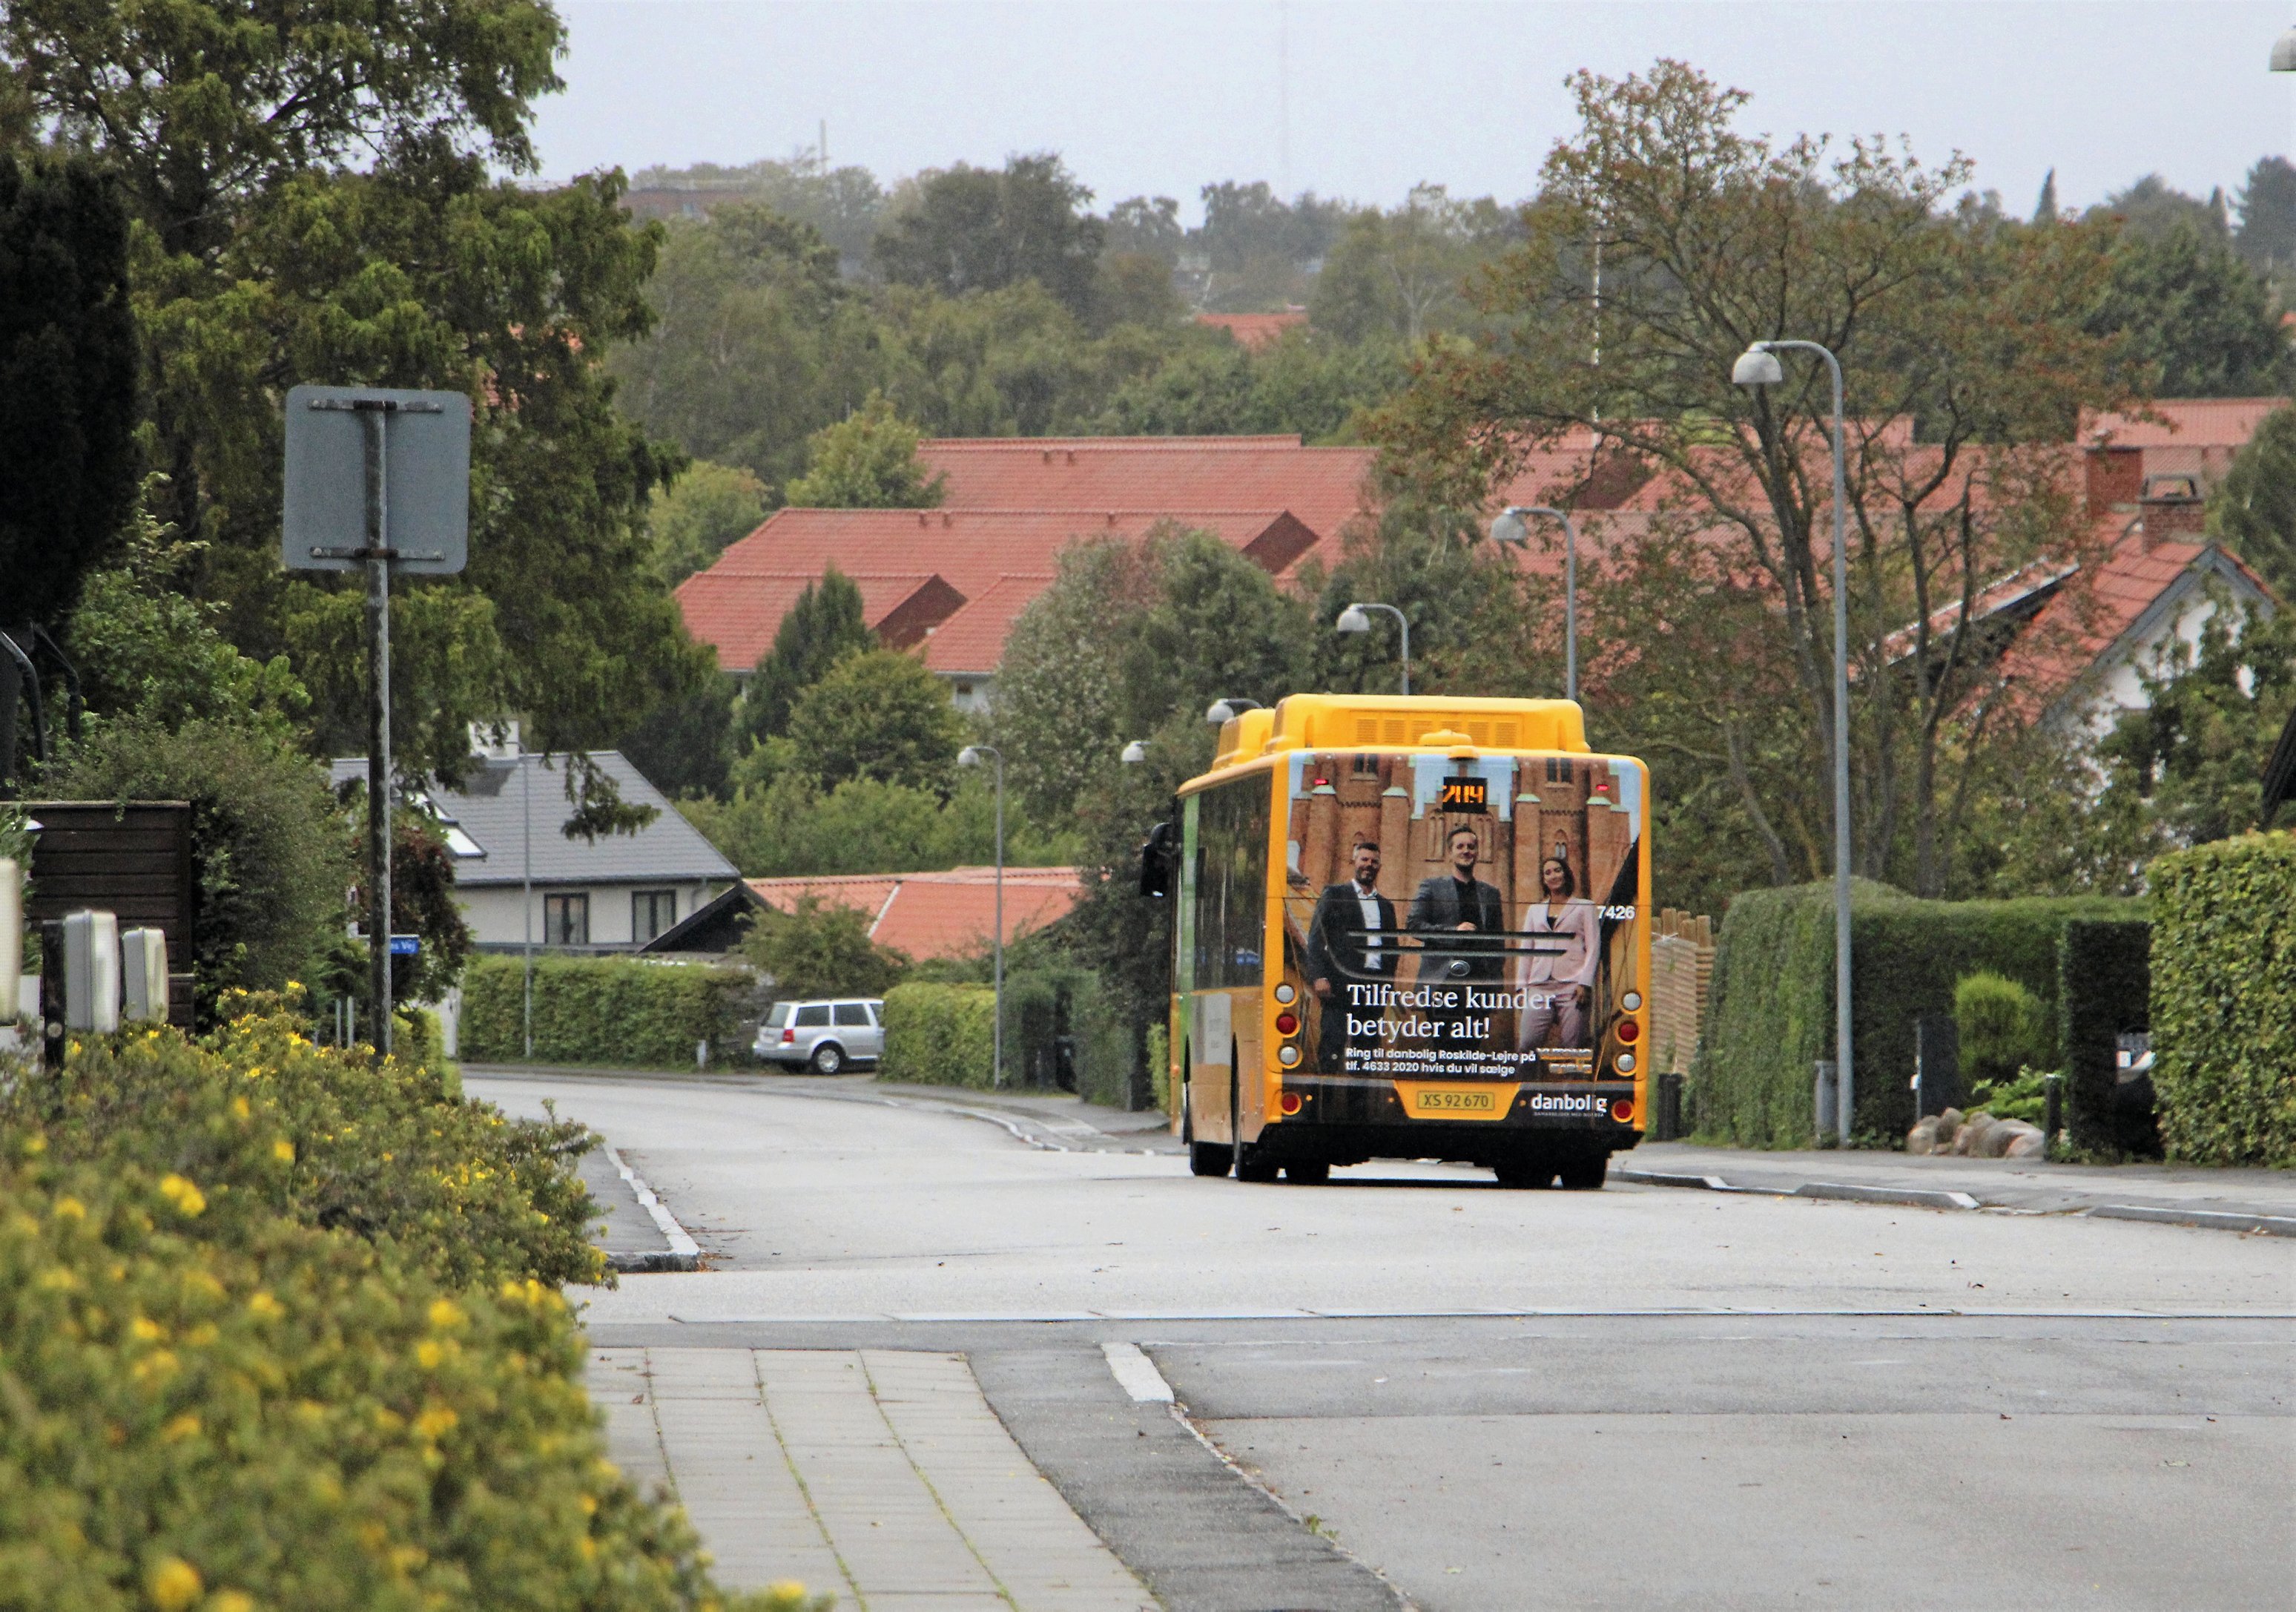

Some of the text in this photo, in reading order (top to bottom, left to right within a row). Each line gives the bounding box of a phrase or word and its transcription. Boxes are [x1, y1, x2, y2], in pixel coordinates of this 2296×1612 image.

[1597, 904, 1636, 920] 7426
[1347, 984, 1556, 1010] Tilfredse kunder
[1346, 1013, 1491, 1043] betyder alt!
[1346, 1047, 1371, 1061] Ring
[1373, 1048, 1385, 1058] til
[1386, 1049, 1437, 1062] danbolig
[1439, 1050, 1519, 1064] Roskilde-Lejre
[1520, 1050, 1536, 1064] på
[1345, 1061, 1516, 1077] tlf. 4633 2020 hvis du vil sælge
[1424, 1094, 1489, 1108] XS 92 670
[1531, 1093, 1608, 1113] danbolg
